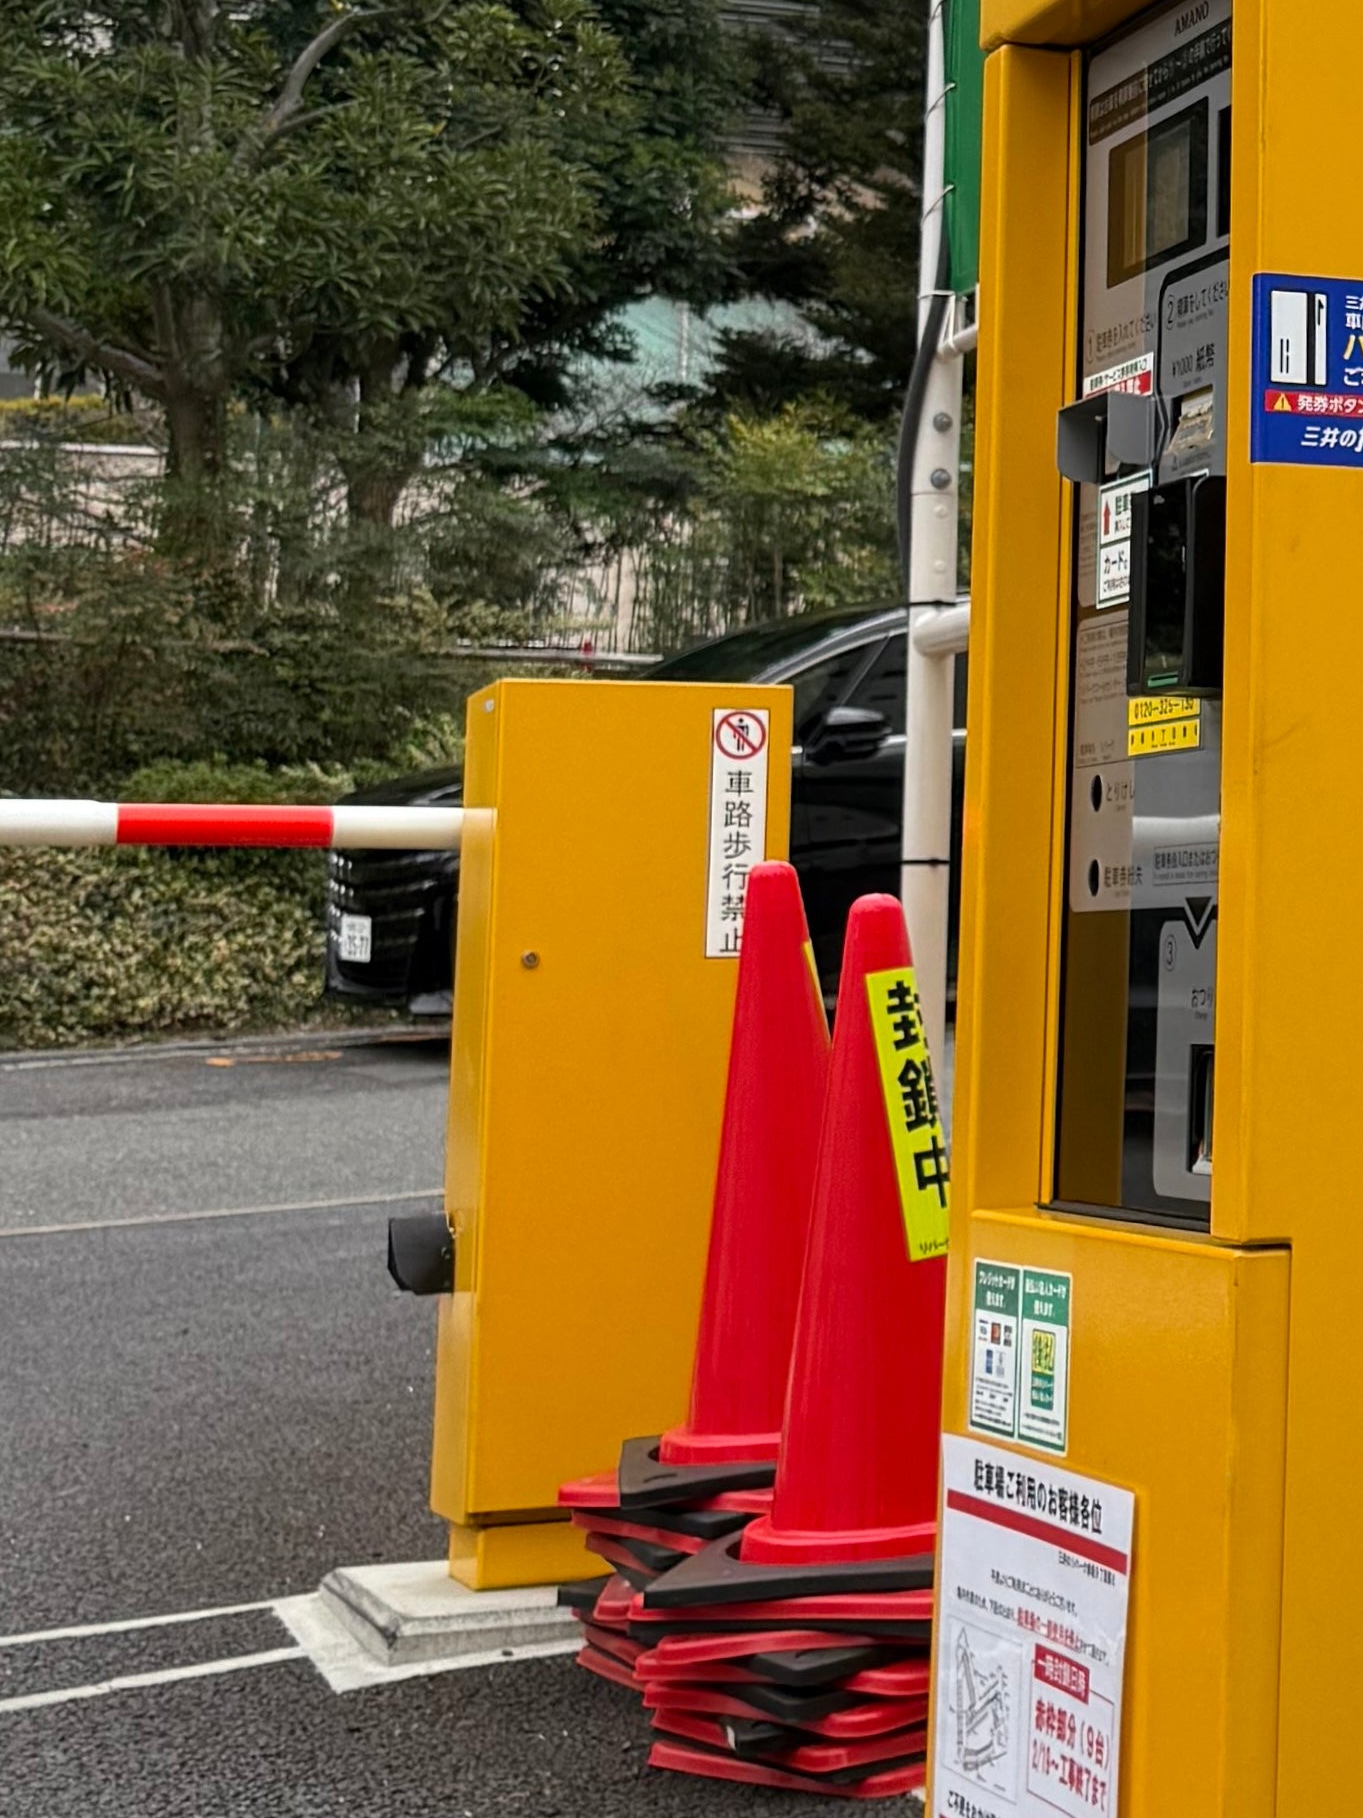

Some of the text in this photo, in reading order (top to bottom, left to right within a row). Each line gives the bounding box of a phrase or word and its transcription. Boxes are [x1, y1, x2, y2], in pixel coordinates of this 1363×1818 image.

[1174, 0, 1210, 36] AMANO
[719, 769, 754, 955] 車路歩行禁止
[886, 979, 950, 1210] 封鎖中
[974, 1458, 1103, 1534] 駐車場ご利用のお客様各位
